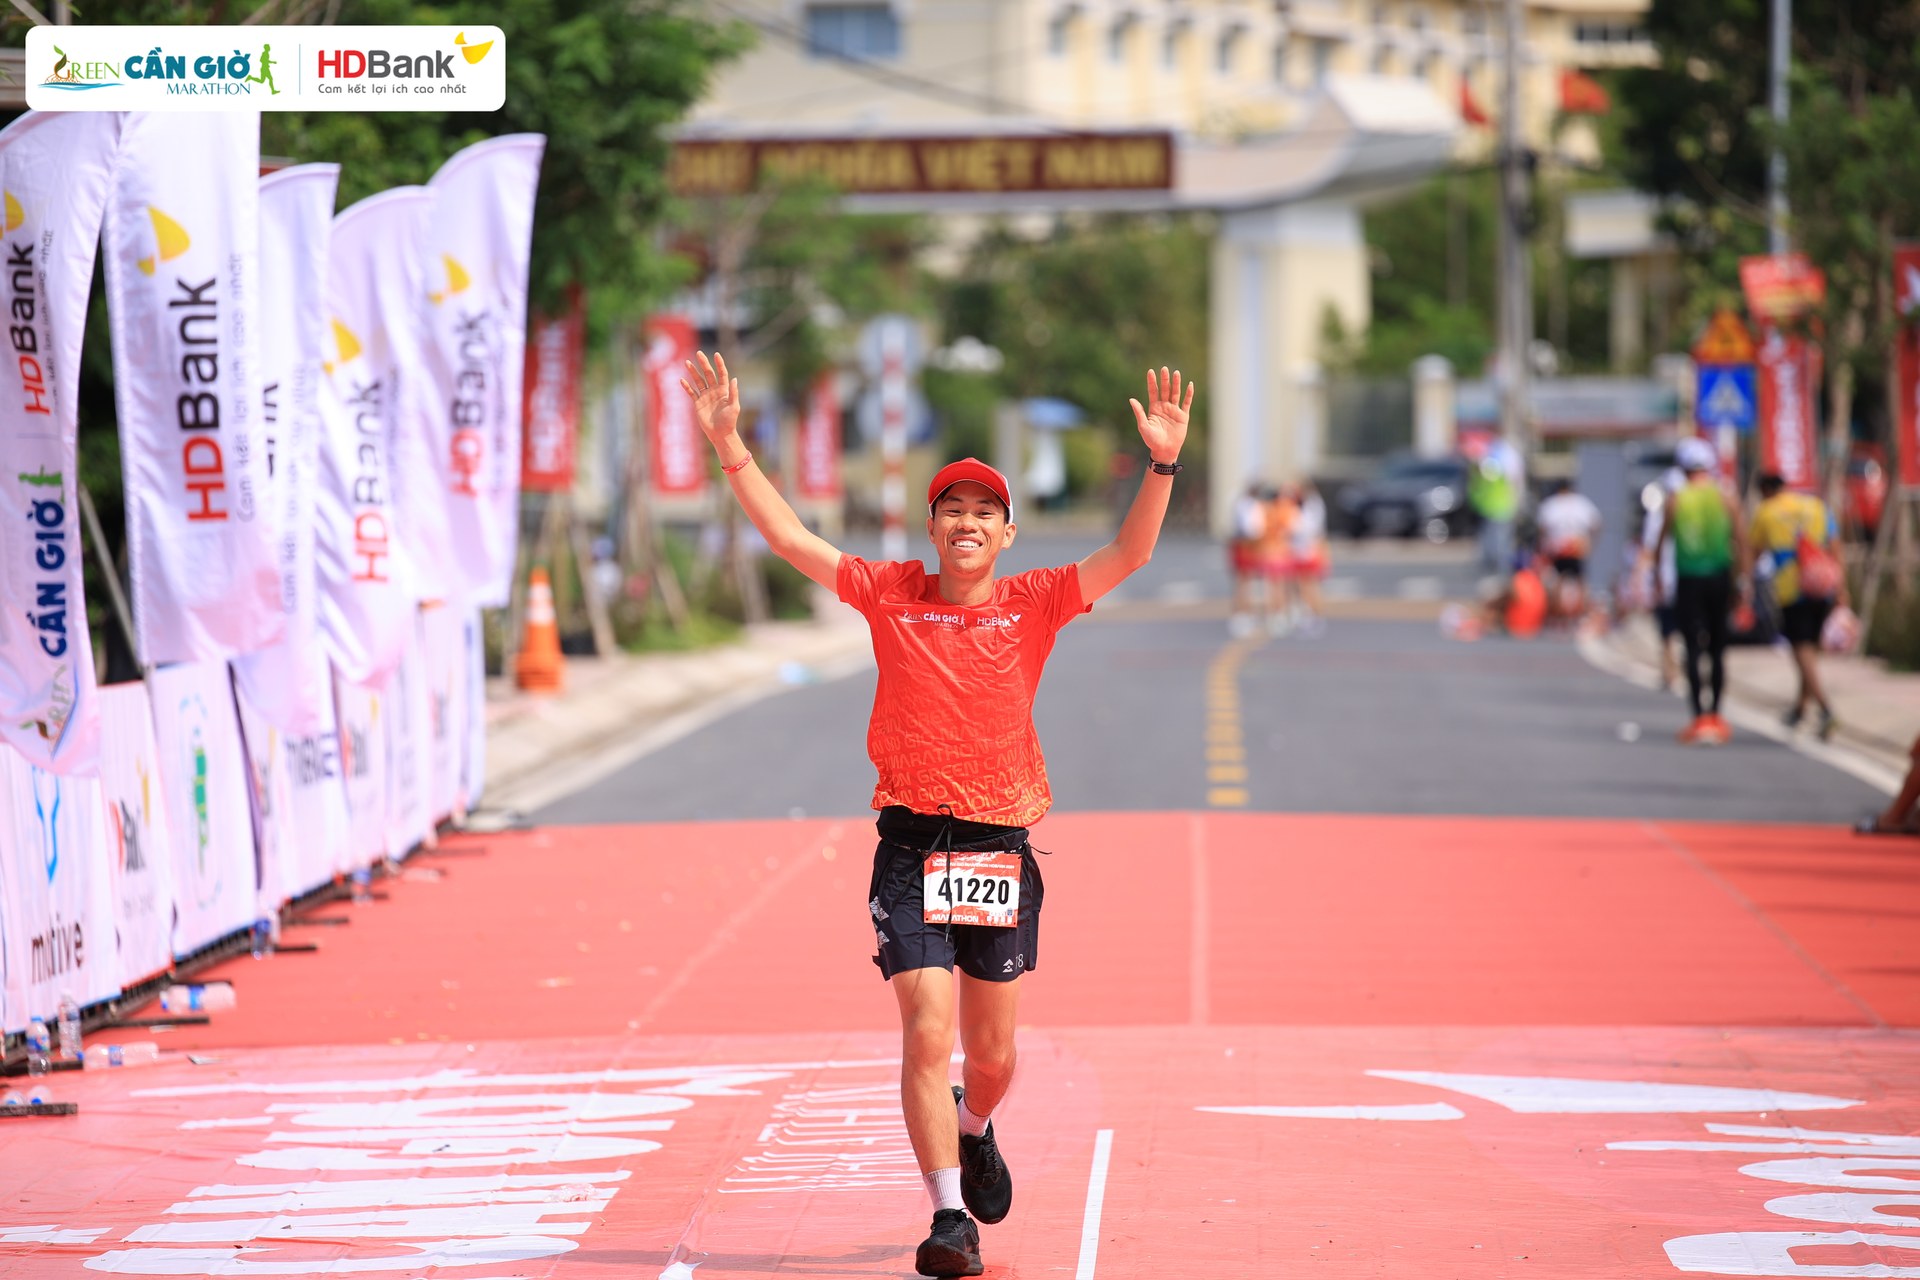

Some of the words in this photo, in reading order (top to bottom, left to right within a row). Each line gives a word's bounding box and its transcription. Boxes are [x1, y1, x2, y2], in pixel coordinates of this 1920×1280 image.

[7, 243, 51, 415] HDBank
[168, 277, 228, 522] HDBank
[27, 499, 66, 572] GIỜ
[937, 877, 1010, 905] 41220
